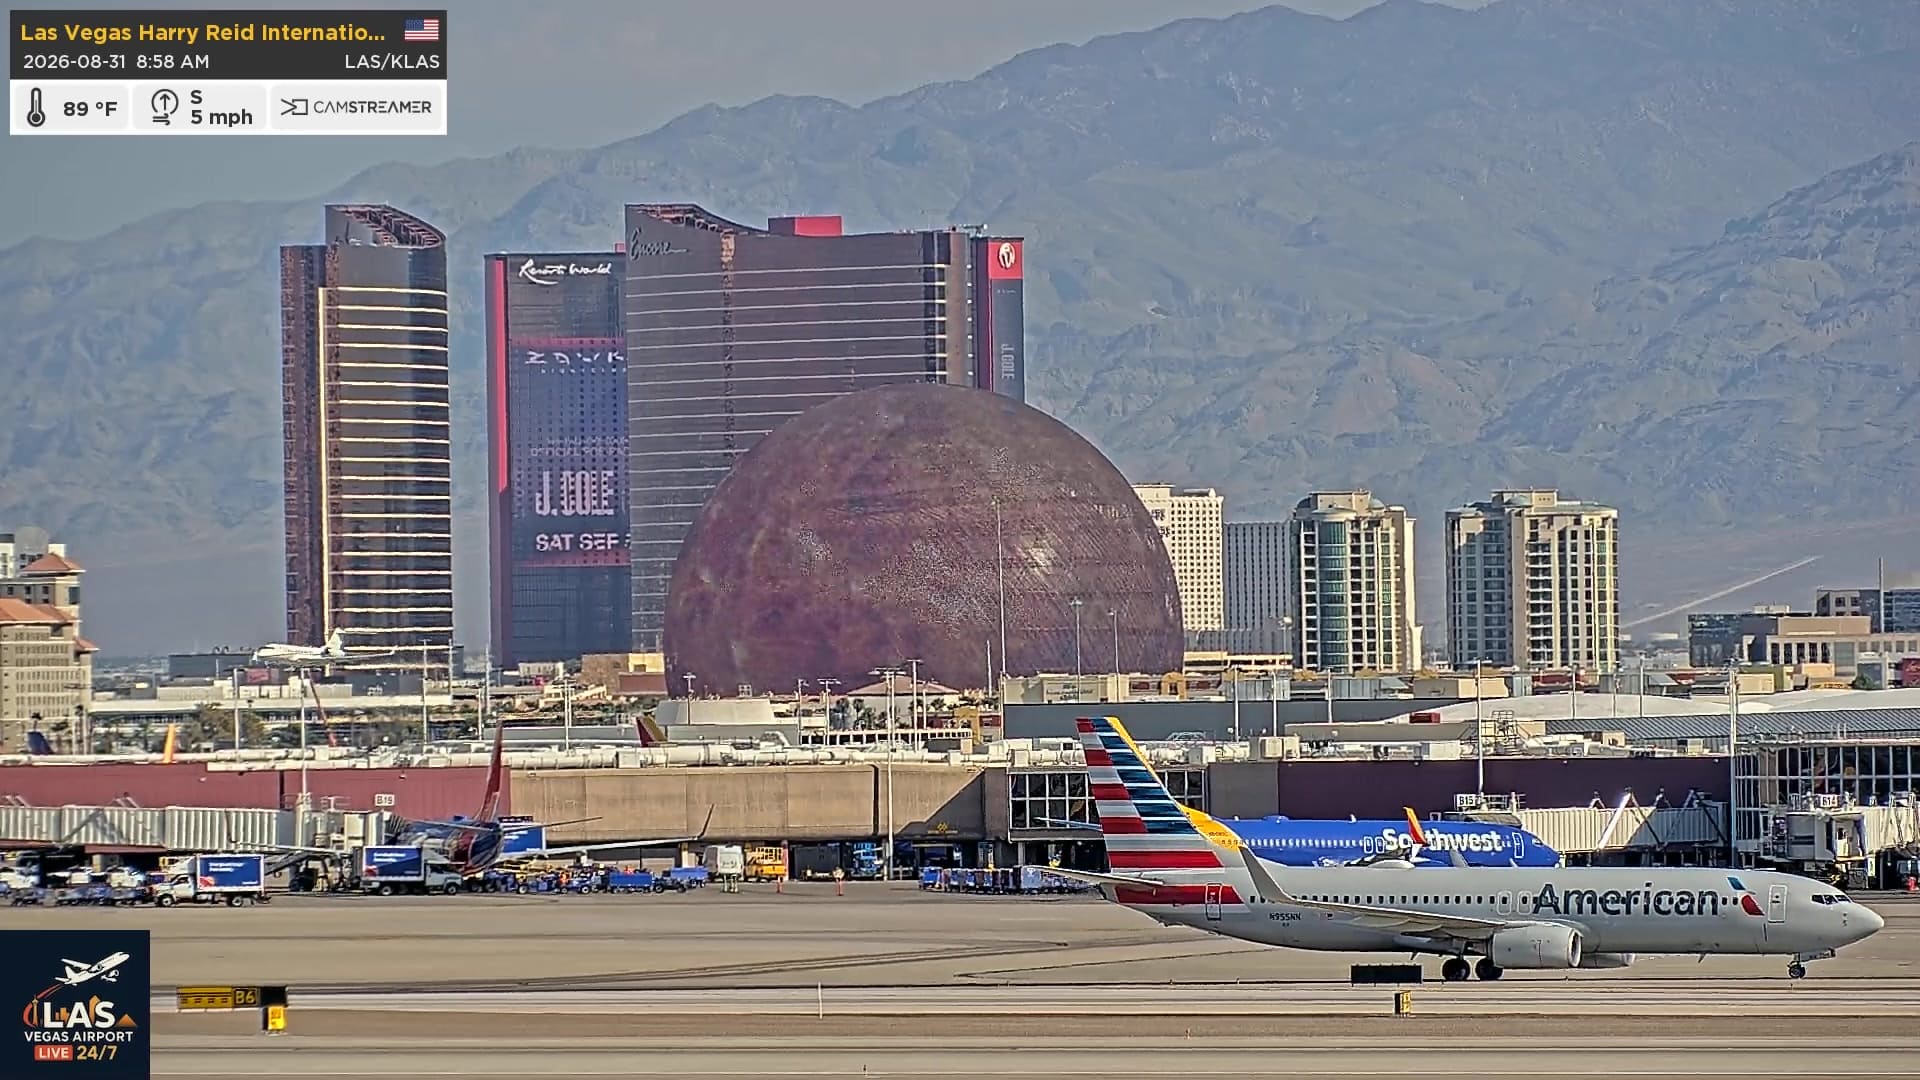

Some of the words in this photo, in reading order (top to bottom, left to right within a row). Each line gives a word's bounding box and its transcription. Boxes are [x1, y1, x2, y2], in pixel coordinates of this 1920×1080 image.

[630, 227, 688, 261] Encore
[519, 259, 567, 285] Resorts
[569, 263, 612, 275] World
[536, 534, 574, 551] SAT
[1459, 795, 1474, 805] B15
[1532, 882, 1719, 916] American
[1269, 912, 1301, 921] N955NN
[235, 990, 256, 1004] B6
